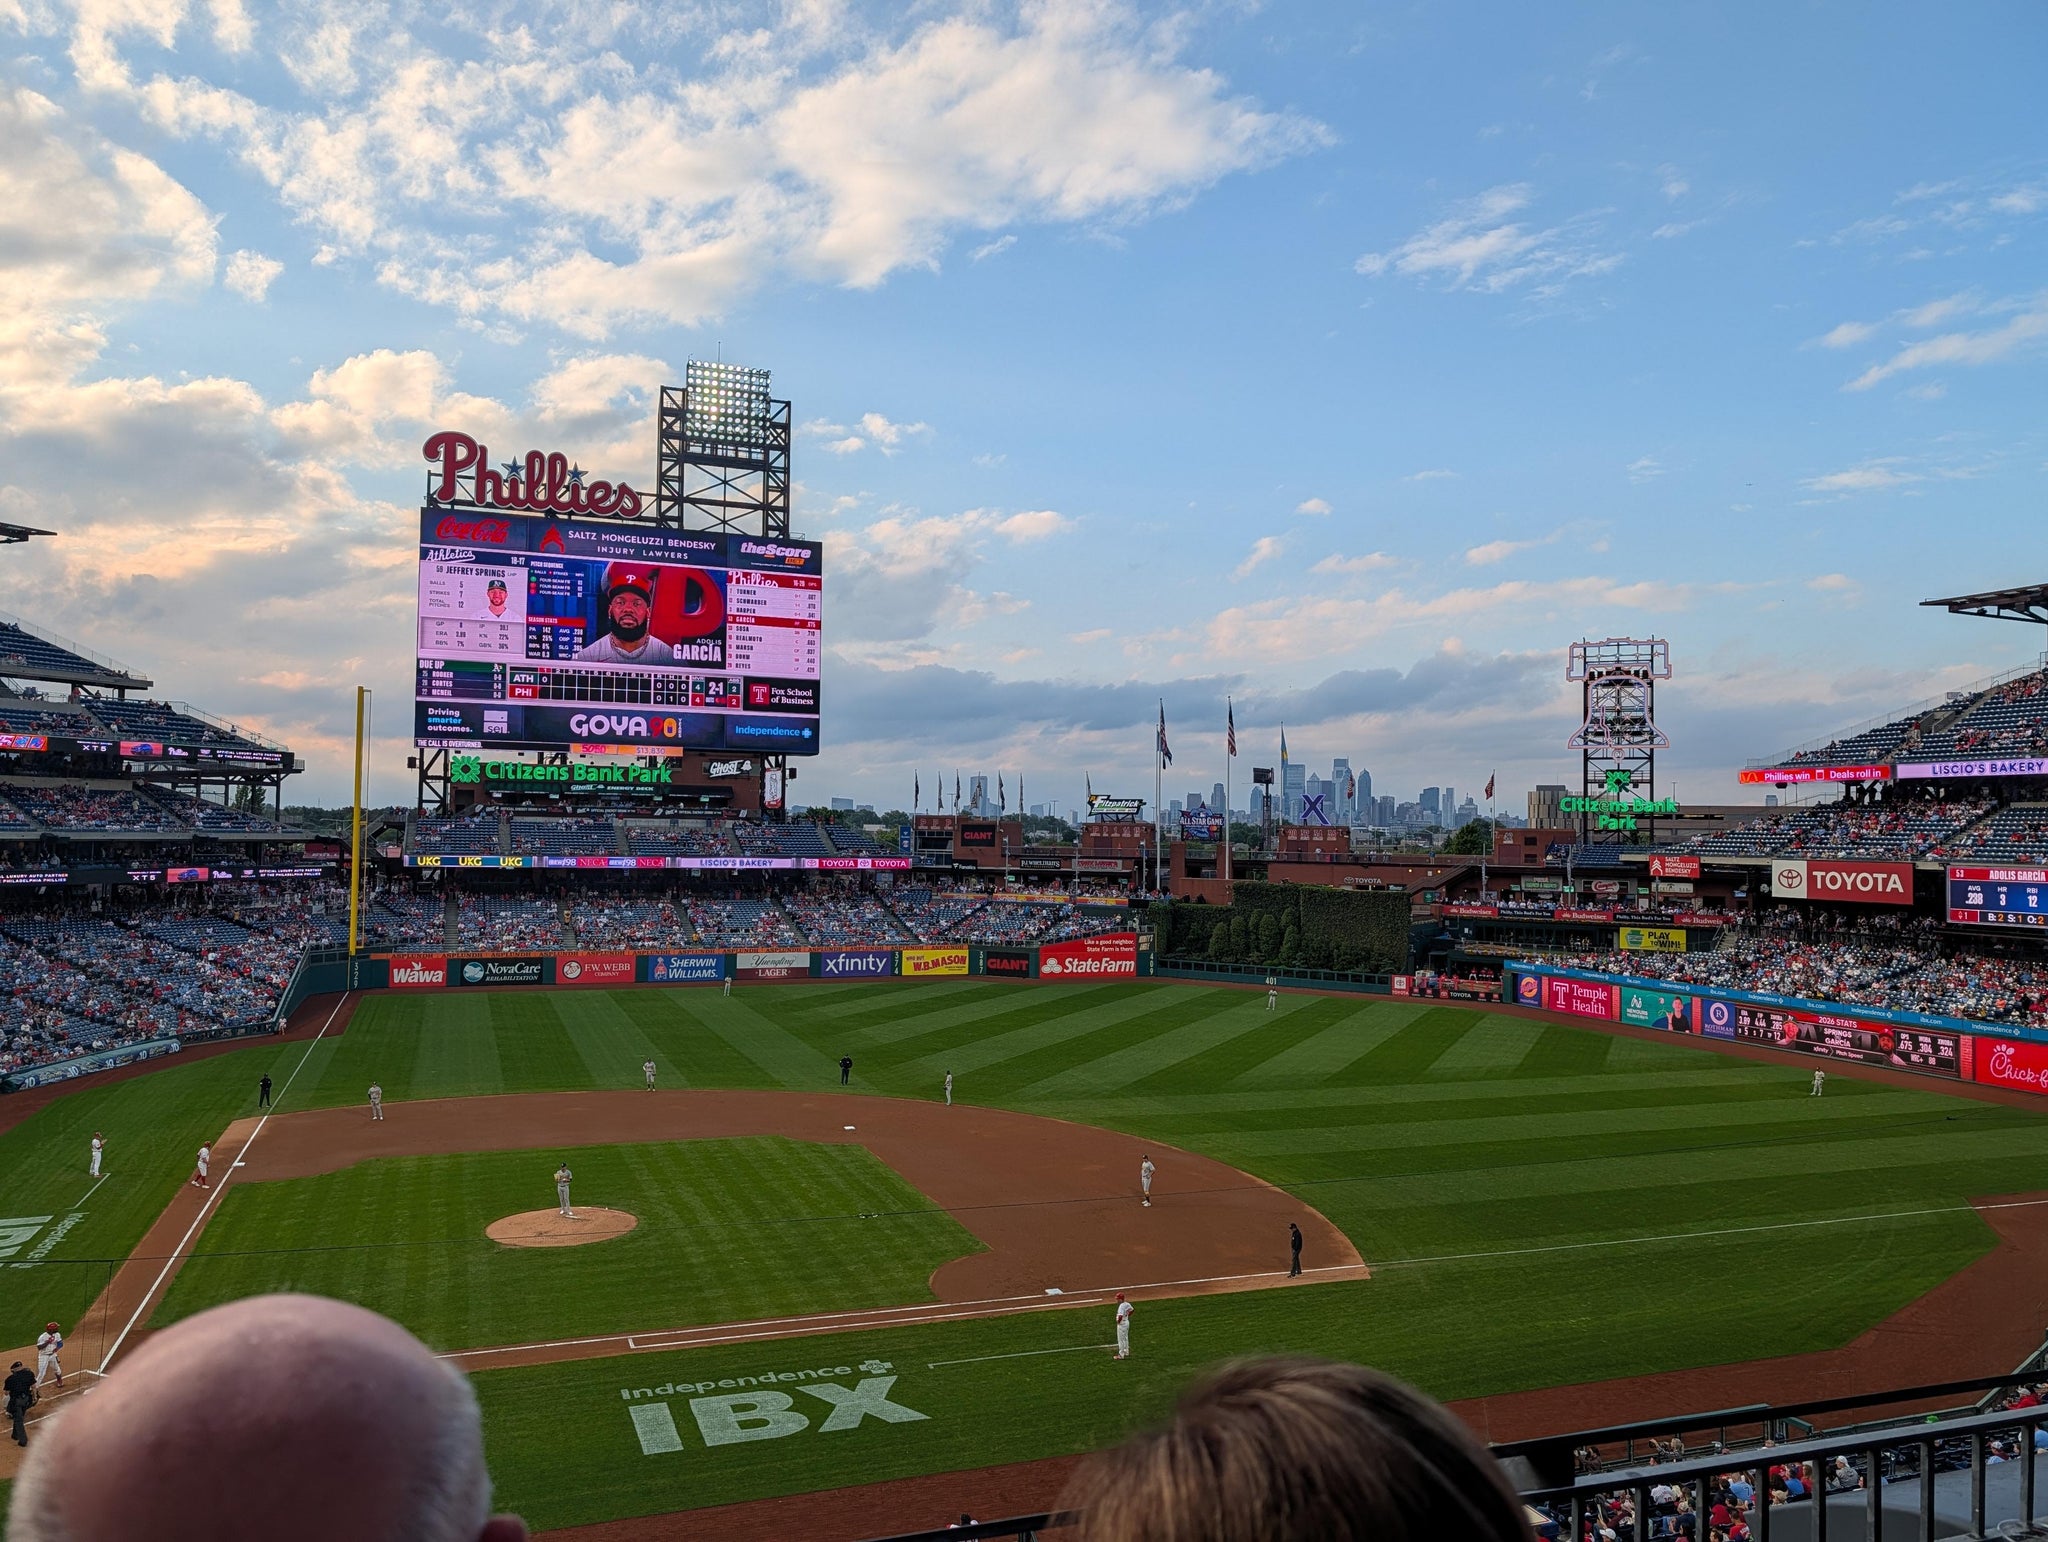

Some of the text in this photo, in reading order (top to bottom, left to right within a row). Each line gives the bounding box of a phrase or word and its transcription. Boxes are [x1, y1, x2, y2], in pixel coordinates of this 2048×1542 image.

[423, 431, 642, 518] Phillies
[568, 530, 716, 551] SALTZ MONGELUZZI BENDESKY
[426, 548, 476, 563] Athletics
[597, 546, 689, 560] INJURY LAWYERS
[740, 541, 812, 558] theScore
[446, 565, 506, 578] JEFFREY SPRINGS
[728, 570, 779, 588] Phillies
[459, 601, 464, 609] 12
[673, 643, 722, 662] GARCÍA
[420, 660, 445, 669] DUE UP
[432, 670, 454, 678] ROOKER
[513, 674, 724, 695] ATH 2-1
[514, 688, 532, 696] PHI
[787, 688, 812, 696] School
[781, 696, 814, 705] Business
[428, 708, 460, 717] Driving
[570, 714, 677, 738] GOYA 90
[735, 725, 800, 736] Independence
[485, 761, 672, 783] Citizens Bank Park
[710, 760, 744, 778] GHOST
[1932, 761, 2044, 775] LISCIO'S BAKERY
[1764, 769, 1881, 781] Phillies win Deals roll in
[1300, 794, 1331, 826] X
[1560, 796, 1679, 813] Citizens Bank
[1180, 817, 1224, 826] ALL STAR GAME
[1598, 815, 1638, 830] Park
[418, 856, 523, 867] UKG UKG UKG
[700, 859, 773, 868] LISCIO'S BAKERY
[874, 860, 907, 868] TOYOTA
[1956, 869, 2046, 882] 53 ADOLIS GARCÍA
[1812, 871, 1904, 893] TOYOTA
[1966, 893, 2038, 908] .238 3 12
[1988, 913, 1996, 921] B:
[1998, 914, 2004, 922] 2
[2008, 914, 2016, 922] S:
[2027, 915, 2037, 924] O:
[2037, 916, 2044, 924] 2
[1648, 932, 1670, 940] PLAY
[1659, 940, 1681, 949] WIN!
[670, 957, 717, 967] SHERWIN
[751, 954, 797, 967] Yuengling
[826, 953, 888, 974] xfinity
[987, 959, 1028, 971] GIANT
[486, 963, 541, 974] NovaCare
[603, 963, 631, 971] WEBB
[758, 969, 788, 977] LAGER
[393, 968, 443, 983] Wawa
[1572, 984, 1608, 1001] Temple
[1572, 1000, 1606, 1016] Health
[1716, 1009, 1722, 1018] R
[1747, 993, 2012, 1034] Independence ibx.com Independence ibx.com Independence
[1739, 1016, 1766, 1027] 3.89 4.44
[1818, 1016, 1858, 1028] 2026 STATS
[1704, 1024, 1734, 1032] ROTHMAN
[1744, 1027, 1780, 1040] 5 7 12
[1824, 1028, 1852, 1038] SPRINGS
[171, 1043, 180, 1052] 10
[1825, 1037, 1851, 1048] GARCÍA
[1898, 1040, 1953, 1057] .675 .304 .324
[139, 1050, 148, 1059] 10
[1813, 1046, 1829, 1054] xfinity
[1848, 1051, 1864, 1059] Speed
[70, 1066, 79, 1076] 10
[24, 1077, 36, 1088] 10
[620, 1365, 852, 1400] Independence
[628, 1375, 932, 1456] IBX
